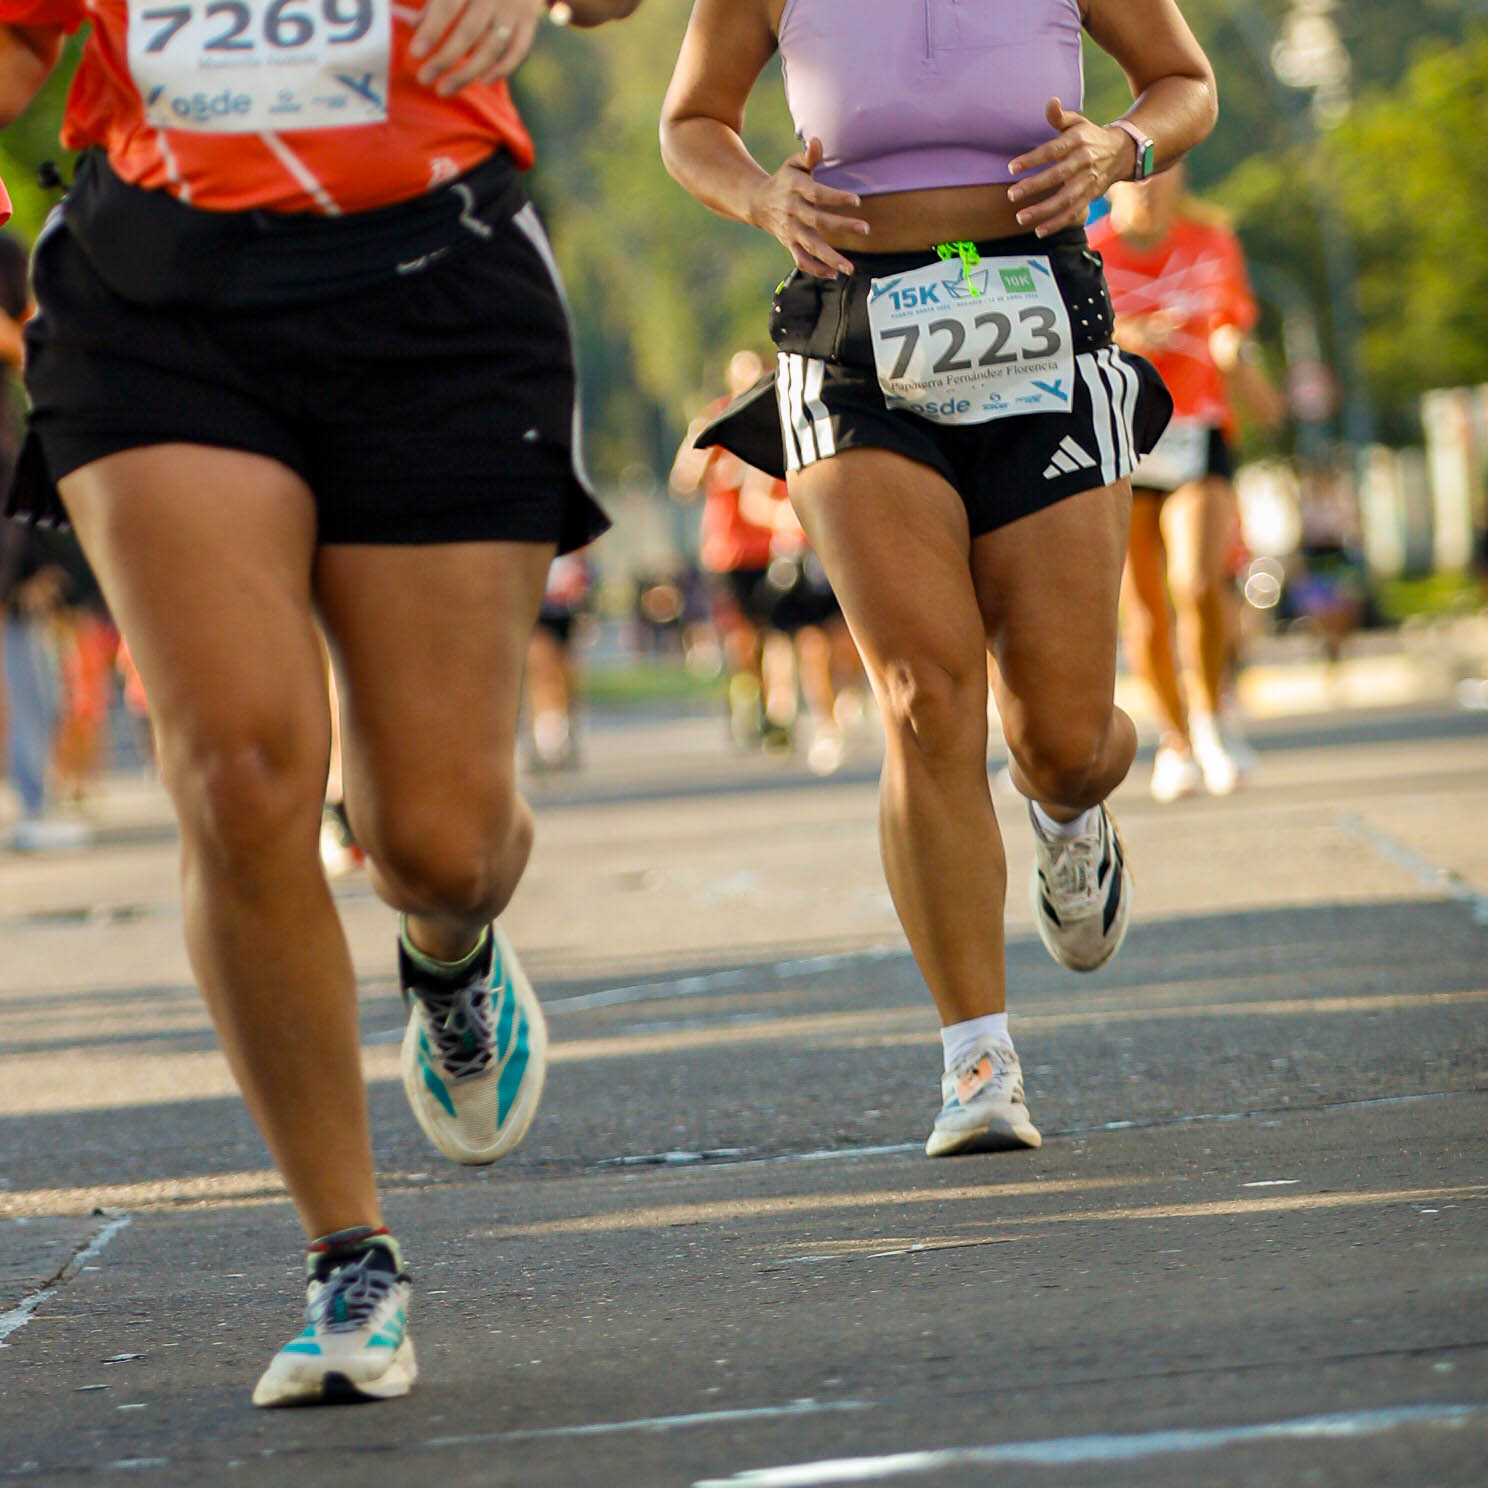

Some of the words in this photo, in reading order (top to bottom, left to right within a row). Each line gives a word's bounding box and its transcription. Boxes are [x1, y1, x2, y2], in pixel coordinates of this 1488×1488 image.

[170, 90, 252, 121] osde
[1004, 272, 1031, 286] 10K
[888, 282, 940, 310] 15K
[879, 305, 1062, 380] 7223
[945, 367, 1004, 387] Fernández
[1005, 361, 1059, 377] Florencia
